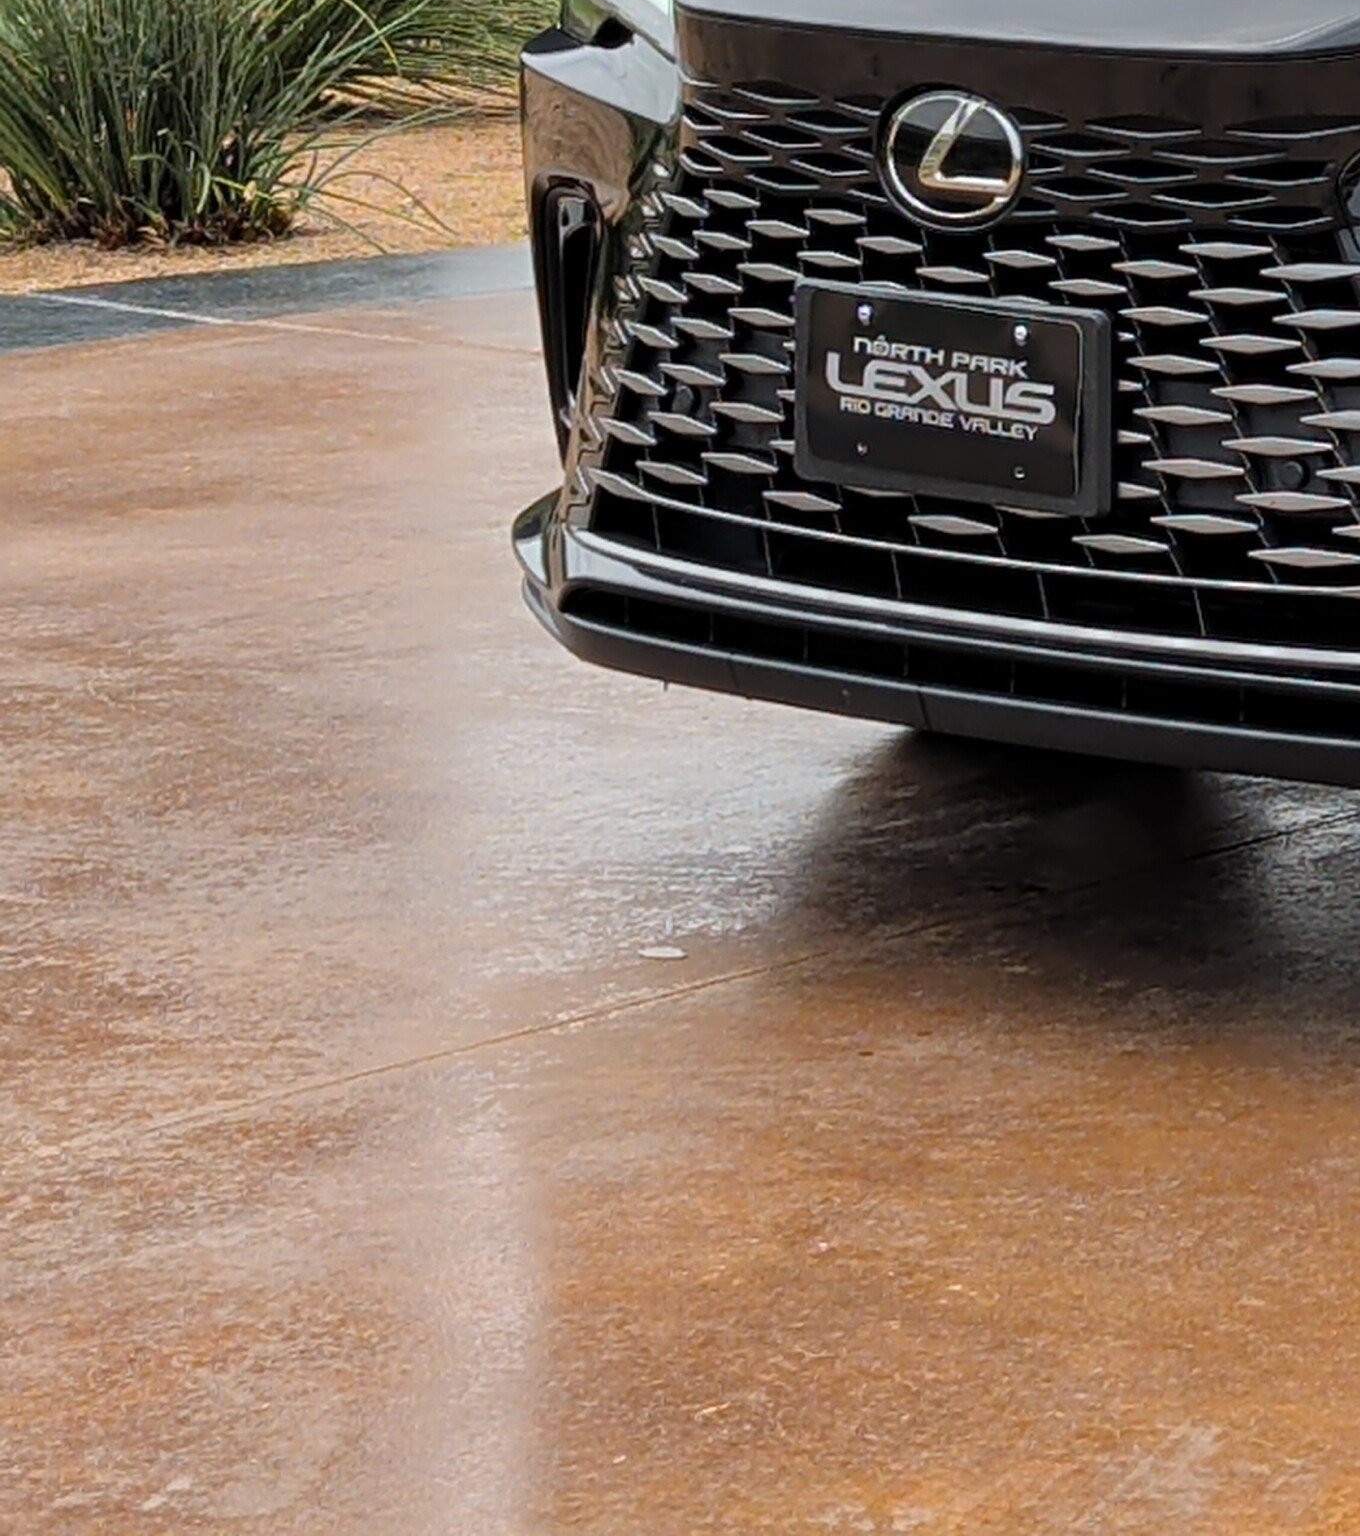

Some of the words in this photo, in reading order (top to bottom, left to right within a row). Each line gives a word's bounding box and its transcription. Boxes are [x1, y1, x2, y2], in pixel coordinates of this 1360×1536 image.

[853, 335, 944, 366] NORTH
[951, 351, 1028, 379] PARK
[825, 351, 1057, 426] LEXUS
[839, 395, 871, 415] RIO
[874, 404, 954, 428] GRANDE
[960, 415, 1039, 441] VALLEY
